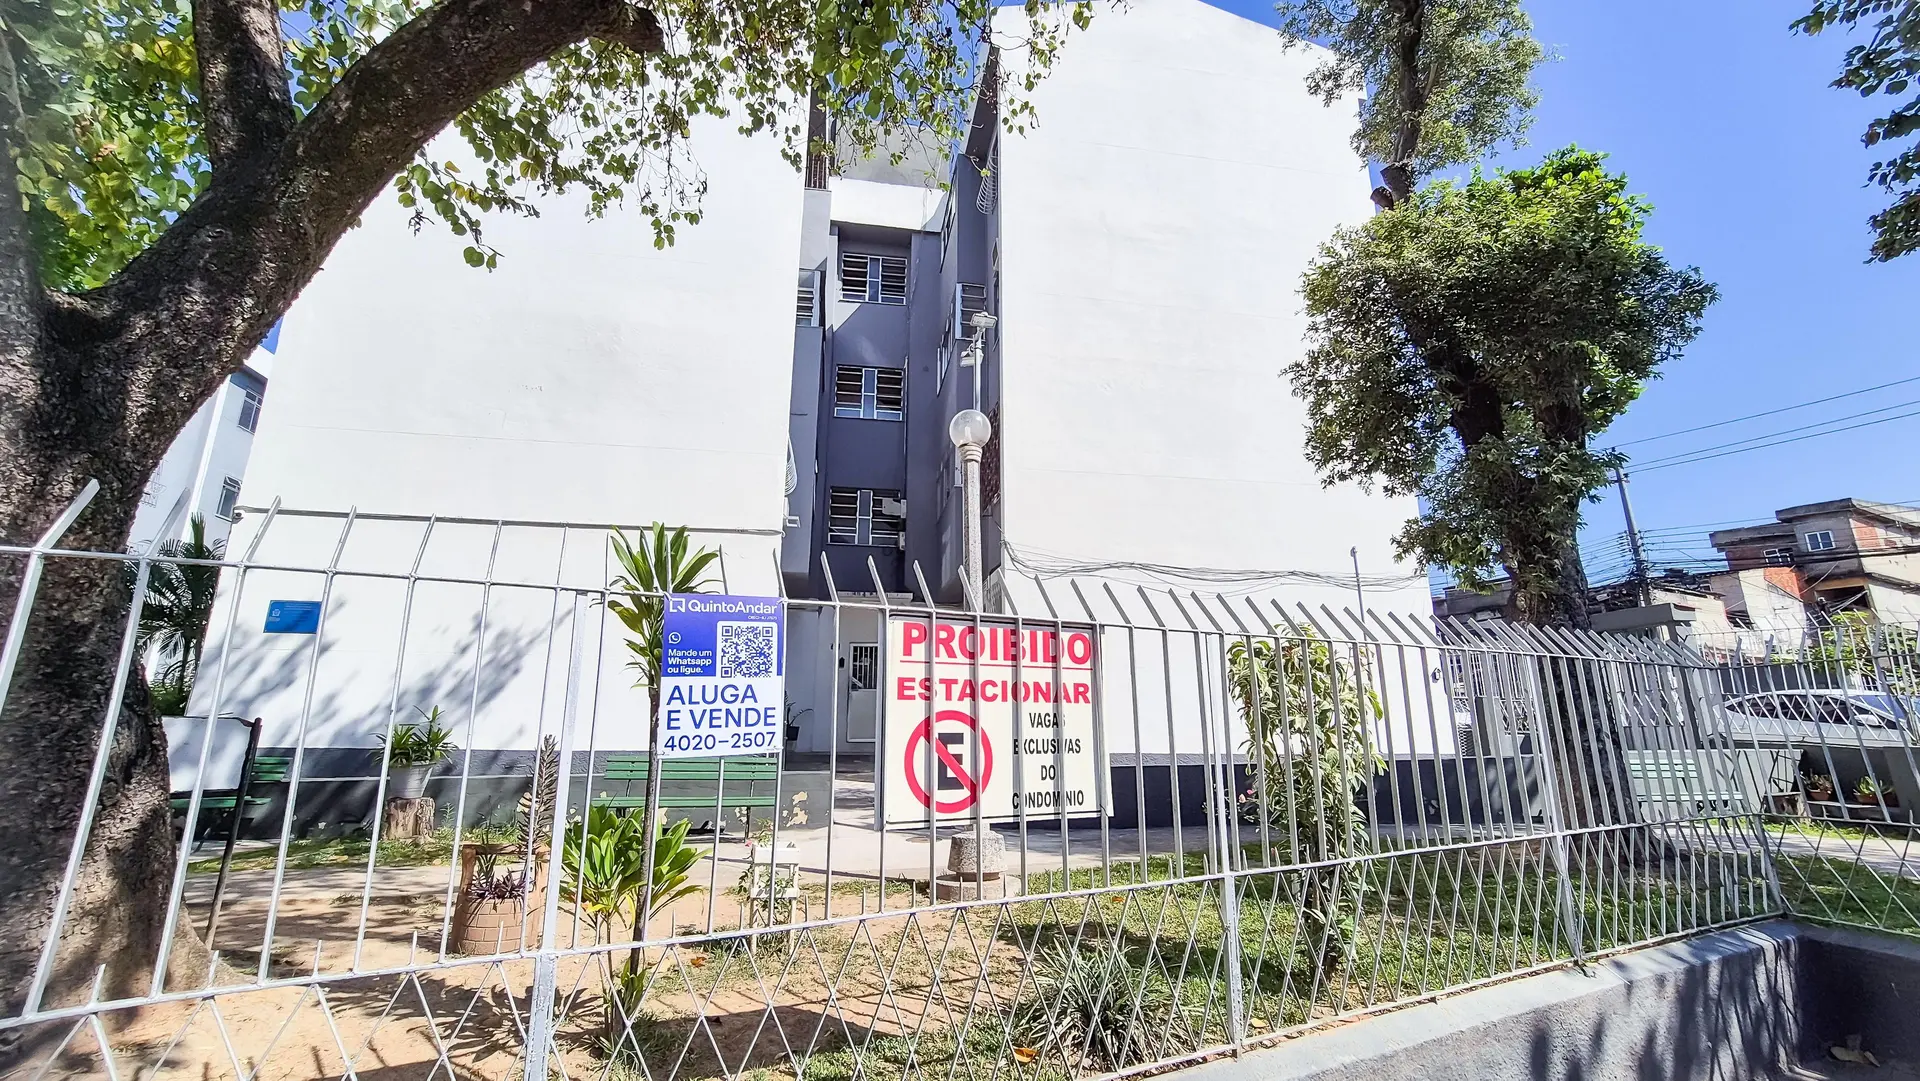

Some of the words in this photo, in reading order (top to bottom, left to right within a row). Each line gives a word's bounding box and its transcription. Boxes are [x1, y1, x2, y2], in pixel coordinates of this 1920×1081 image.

[688, 600, 777, 614] QuintoAndar
[668, 648, 697, 657] Mande
[902, 621, 1092, 665] PROIBIDO
[668, 657, 712, 667] Whatsapp
[680, 666, 703, 675] ligue.
[666, 684, 758, 706] ALUGA
[897, 676, 1091, 704] ESTACIONAR
[667, 709, 681, 730] E
[689, 707, 776, 730] VENDE
[664, 731, 776, 751] 4020-2507
[1040, 765, 1056, 781] DO
[1012, 790, 1084, 810] CNDOMNIO
